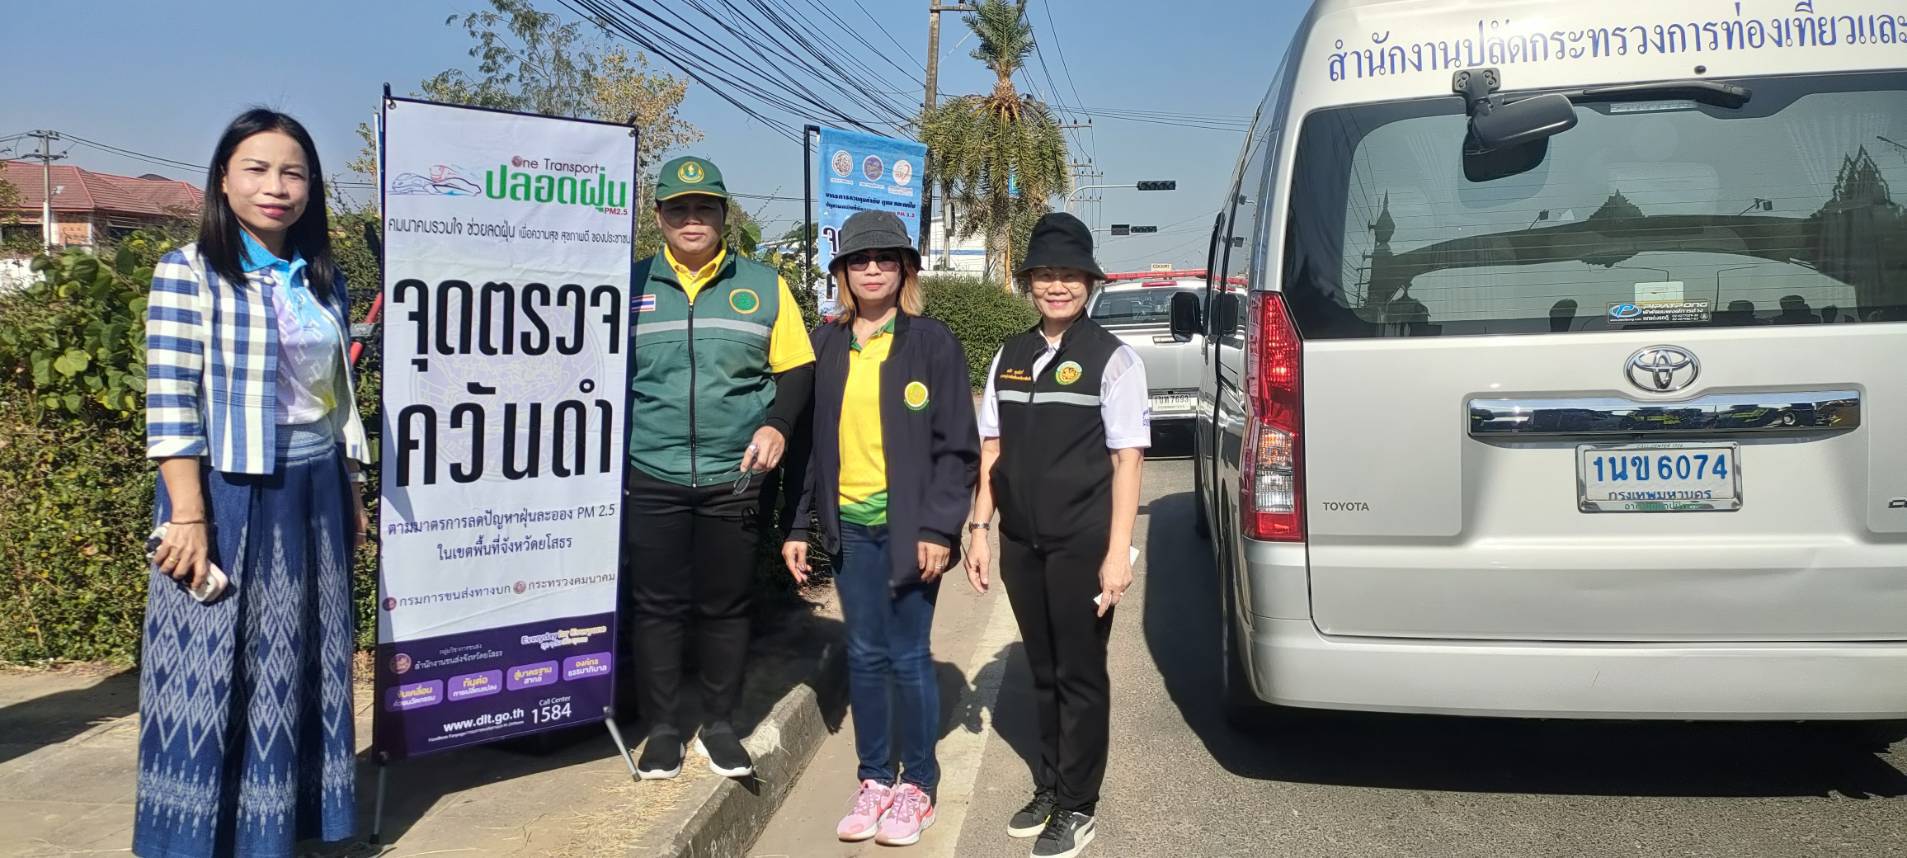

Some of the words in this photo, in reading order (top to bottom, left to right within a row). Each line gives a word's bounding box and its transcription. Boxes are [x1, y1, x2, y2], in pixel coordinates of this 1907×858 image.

[1328, 0, 1907, 82] สำนักงานปลัดกระทรวงการท่องเทียวและ
[511, 155, 539, 169] One
[544, 158, 600, 177] Transport
[485, 164, 627, 212] ปลอดฝุ่น
[604, 207, 628, 216] PM2.5
[388, 216, 463, 236] คมนาคมรวมใจ
[467, 217, 516, 242] ช่วยลดฝุ่น
[519, 224, 559, 243] เพื่อความสุข
[561, 229, 590, 243] สุขภาพดี
[393, 278, 622, 373] จุดตรวจ
[396, 378, 613, 488] ควันดำ
[1593, 455, 1650, 482] 1นข
[1657, 453, 1728, 481] 6074
[1322, 502, 1370, 511] TOYOTA
[1608, 489, 1712, 501] กรงเทพมหานคร
[388, 509, 574, 536] ตามมาตรการลดปัญหาฝุ่นละออง
[577, 506, 595, 519] PM
[598, 504, 615, 517] 2.5
[437, 533, 573, 561] ในเขตพื้นที่จังหวัดยโสธร
[528, 572, 616, 591] กระทรวงคมนาคม
[399, 583, 511, 607] กรมการขนส่งทางบก
[531, 702, 573, 725] 1584
[538, 698, 551, 706] Call
[551, 695, 571, 704] Center
[443, 707, 525, 733] www.dlt.go.th
